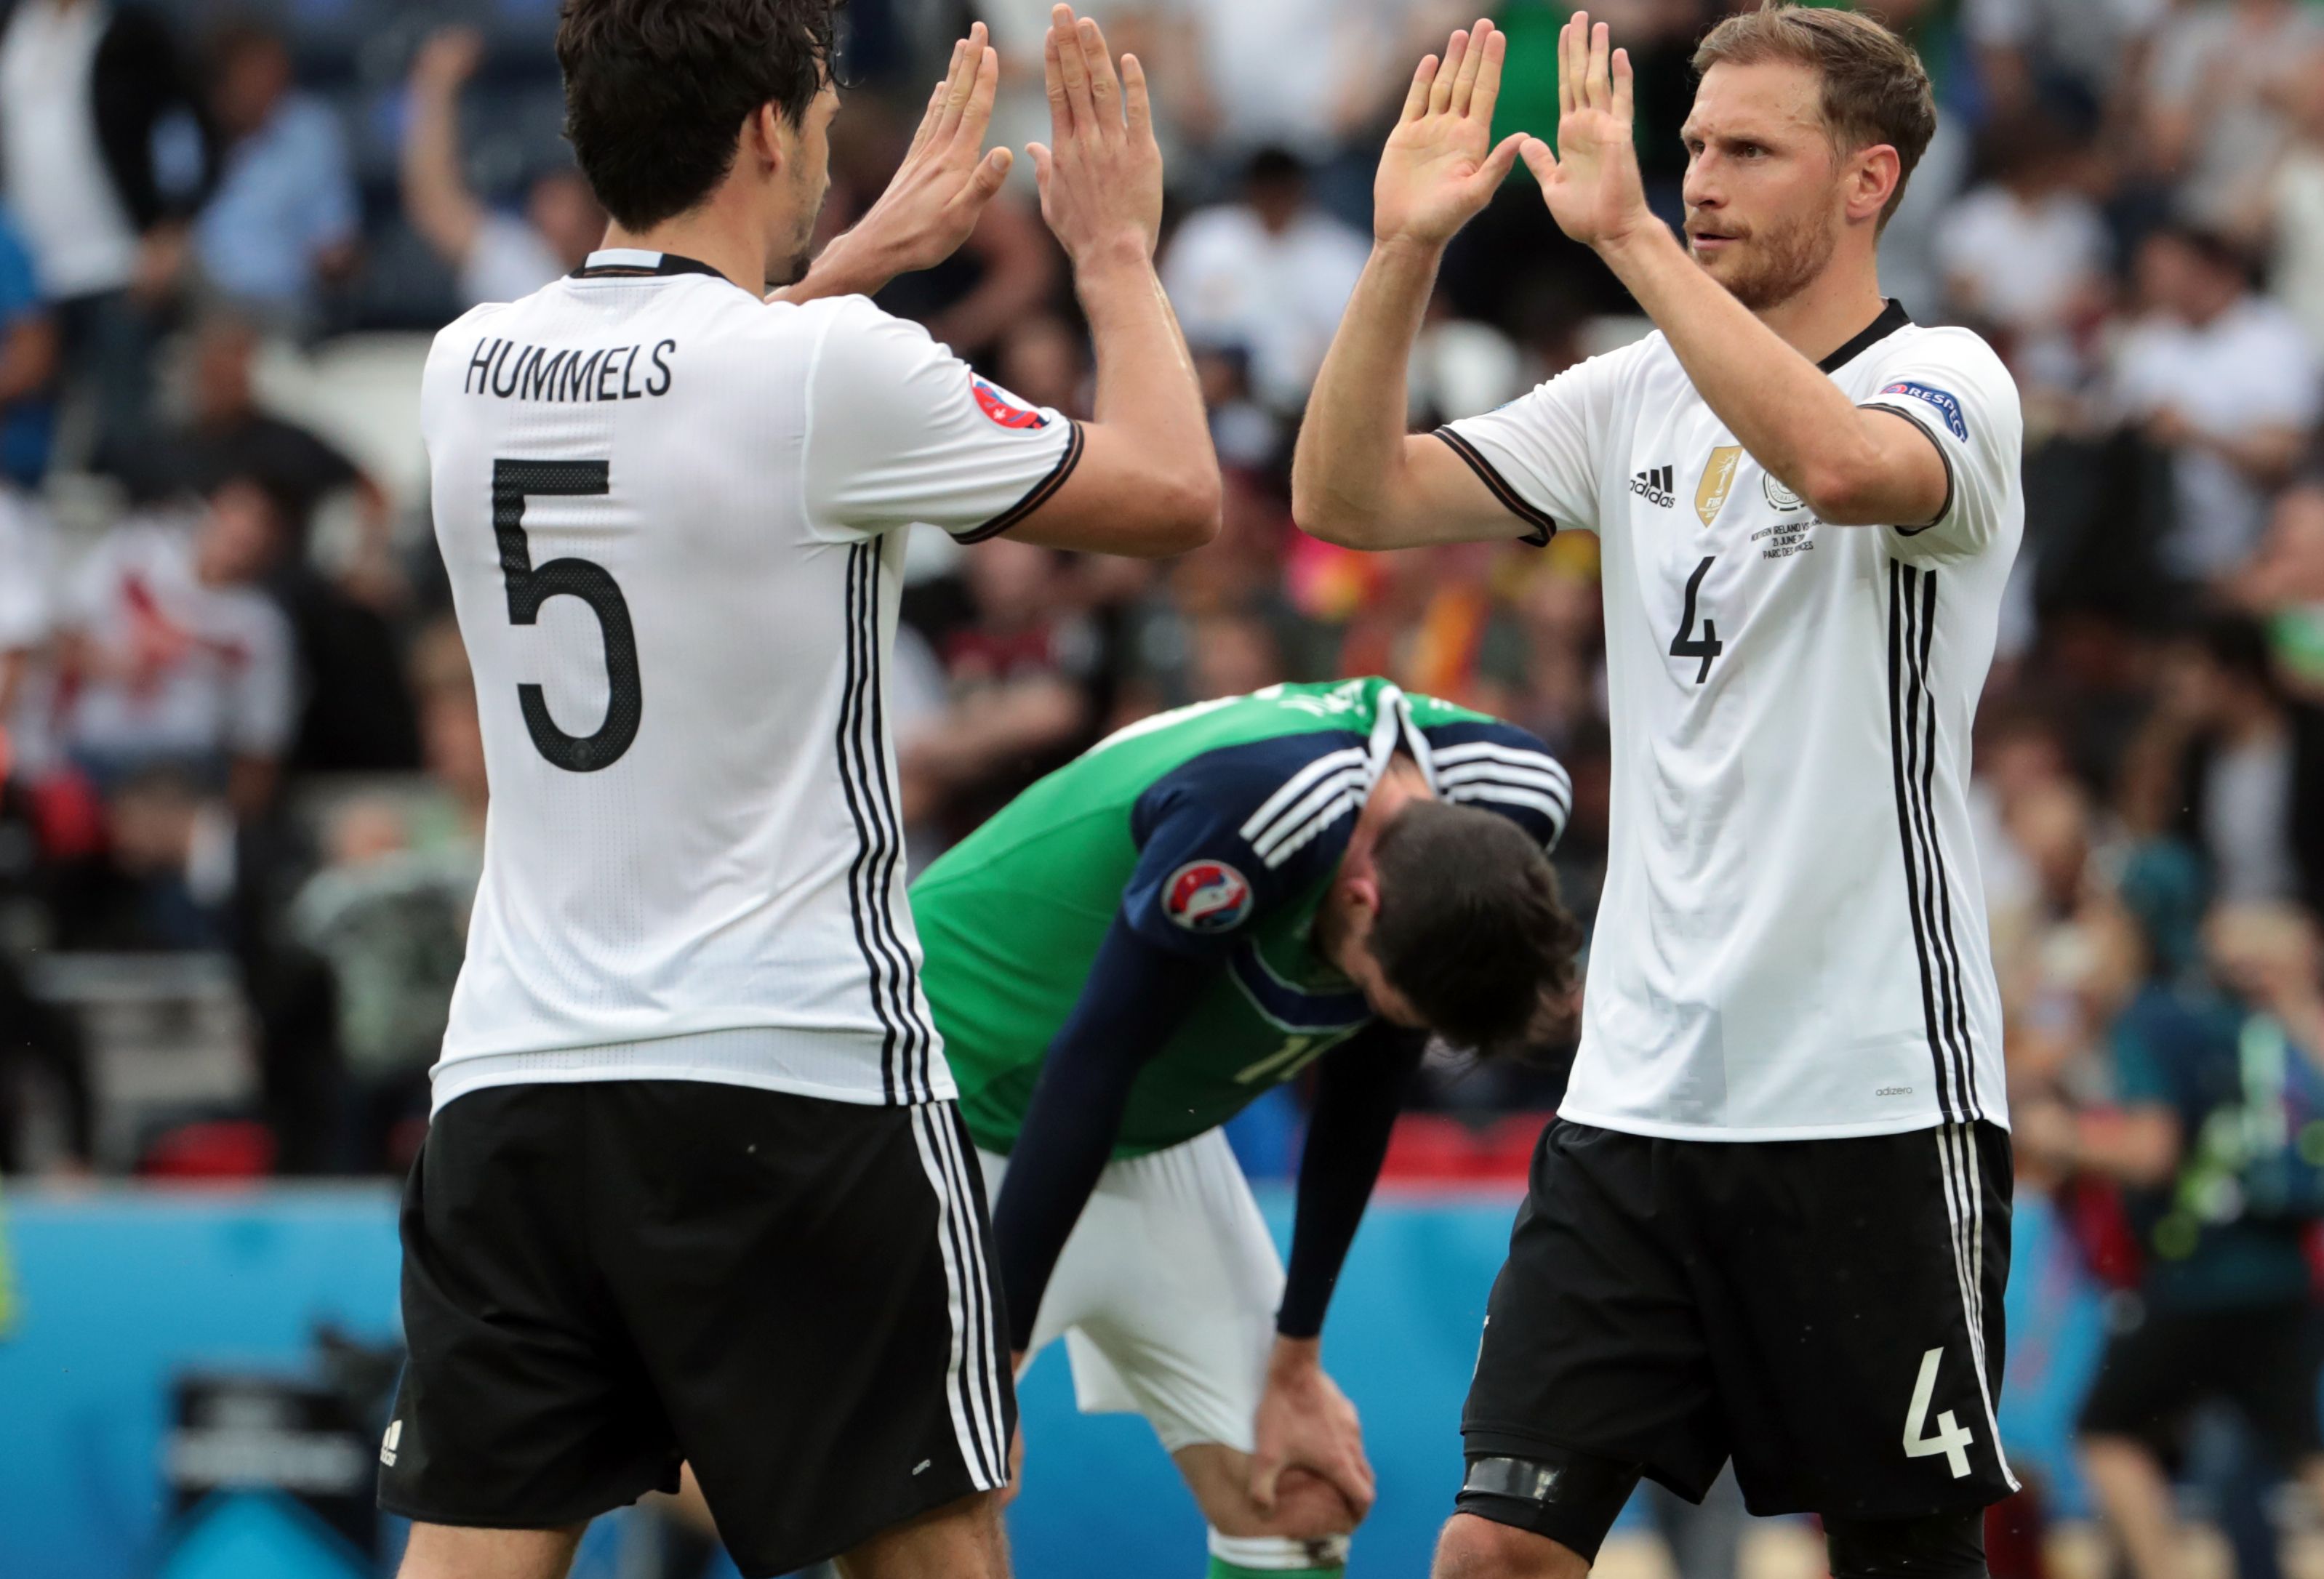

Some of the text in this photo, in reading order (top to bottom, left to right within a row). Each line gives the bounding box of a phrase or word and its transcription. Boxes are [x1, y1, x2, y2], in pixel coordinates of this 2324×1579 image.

[464, 337, 676, 402] HUMMELS
[1908, 387, 1966, 442] RESPECT
[1763, 548, 1782, 560] PARC
[1782, 547, 1794, 557] DES
[1774, 523, 1801, 535] IRELAND
[1780, 534, 1797, 546] JUNE
[492, 459, 642, 772] 5
[1669, 555, 1723, 685] 4
[1875, 1085, 1913, 1096] adizero
[1902, 1346, 1974, 1479] 4
